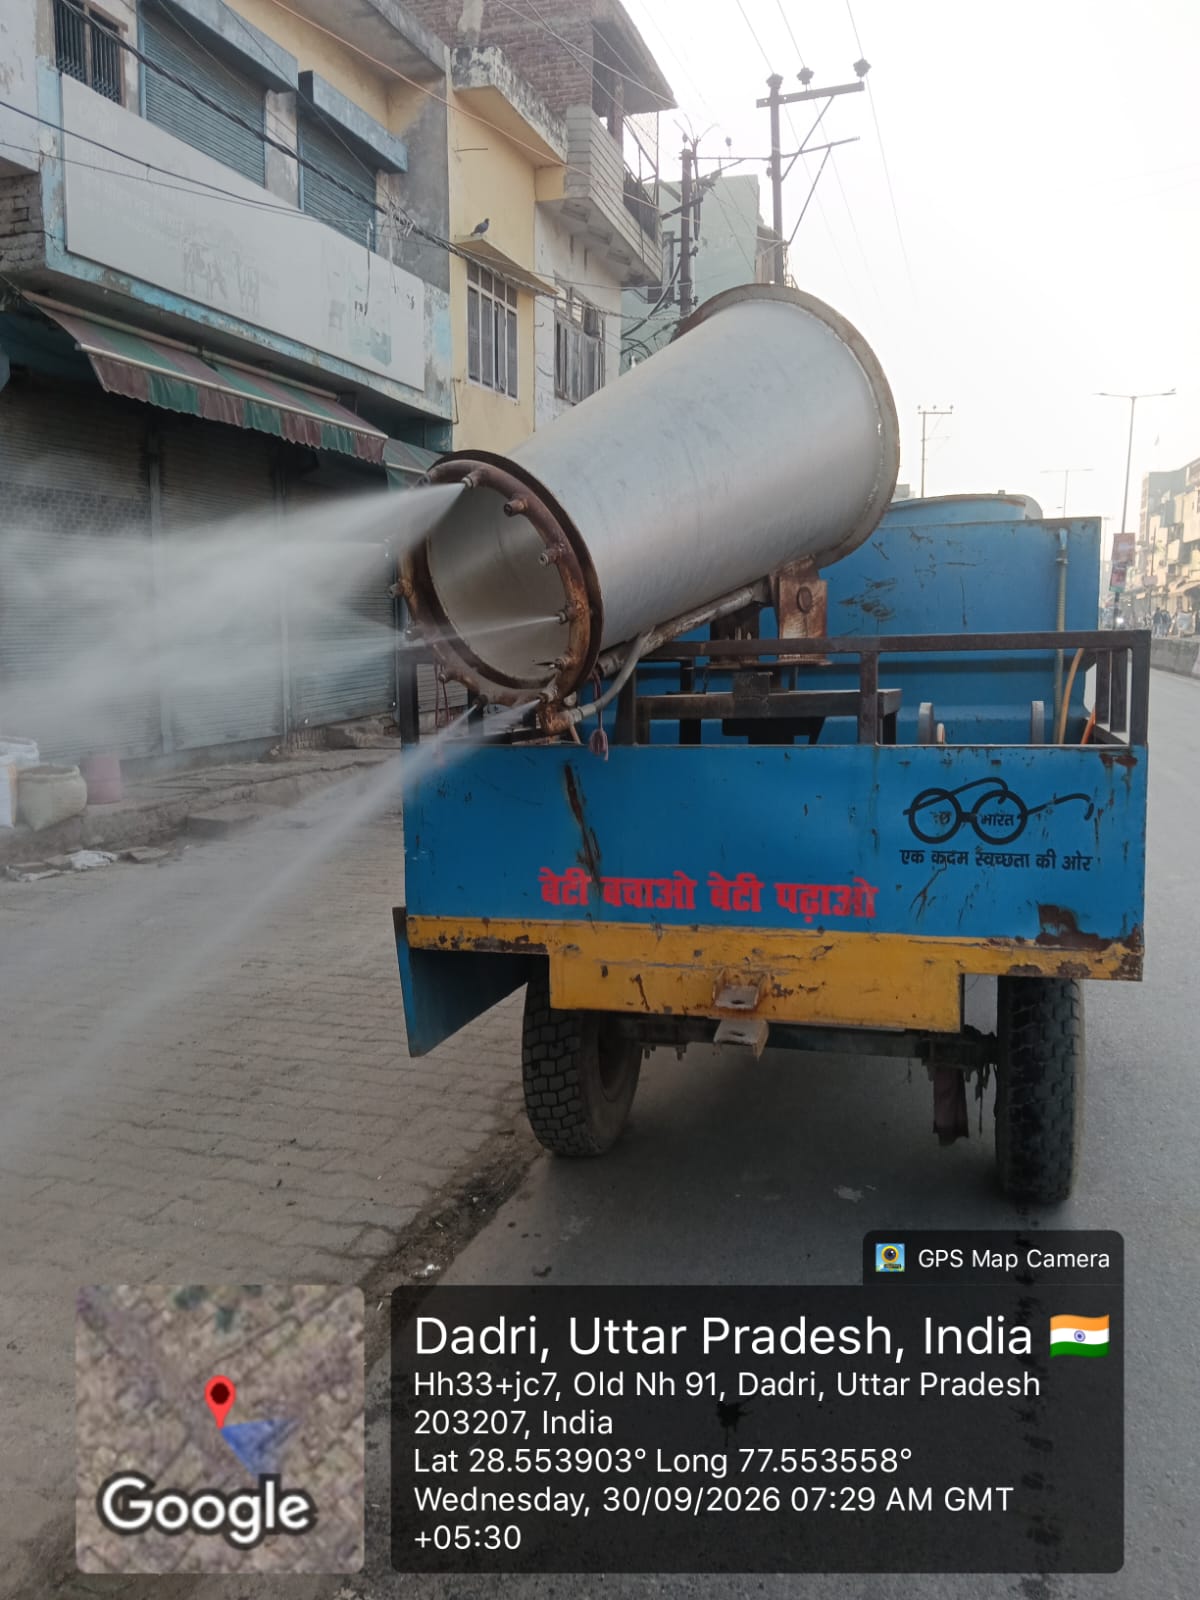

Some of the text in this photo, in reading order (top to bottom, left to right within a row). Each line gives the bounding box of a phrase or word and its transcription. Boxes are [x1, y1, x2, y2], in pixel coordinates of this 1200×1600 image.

[980, 813, 1015, 827] भारत
[900, 848, 1093, 871] एक कदम स्वच्छता की ओर
[538, 867, 880, 924] बेटी बचाओ बेटी पढ़ाओ
